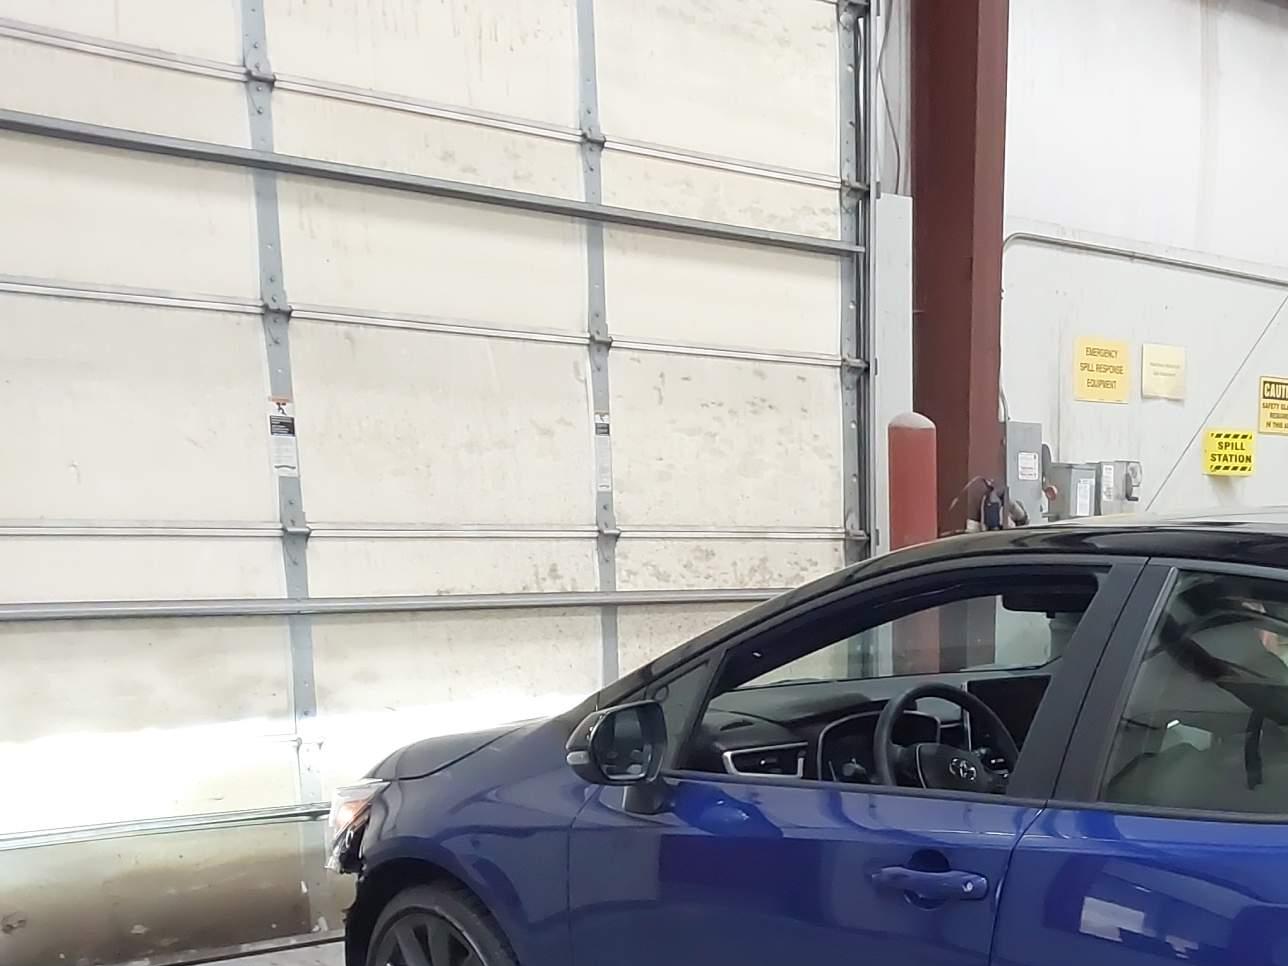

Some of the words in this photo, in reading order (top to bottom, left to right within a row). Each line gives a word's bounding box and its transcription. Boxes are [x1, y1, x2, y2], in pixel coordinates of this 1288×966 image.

[1079, 362, 1095, 373] SPILL
[1262, 402, 1280, 410] SAFETY
[1217, 441, 1246, 451] SPILL
[1210, 453, 1252, 463] STATION
